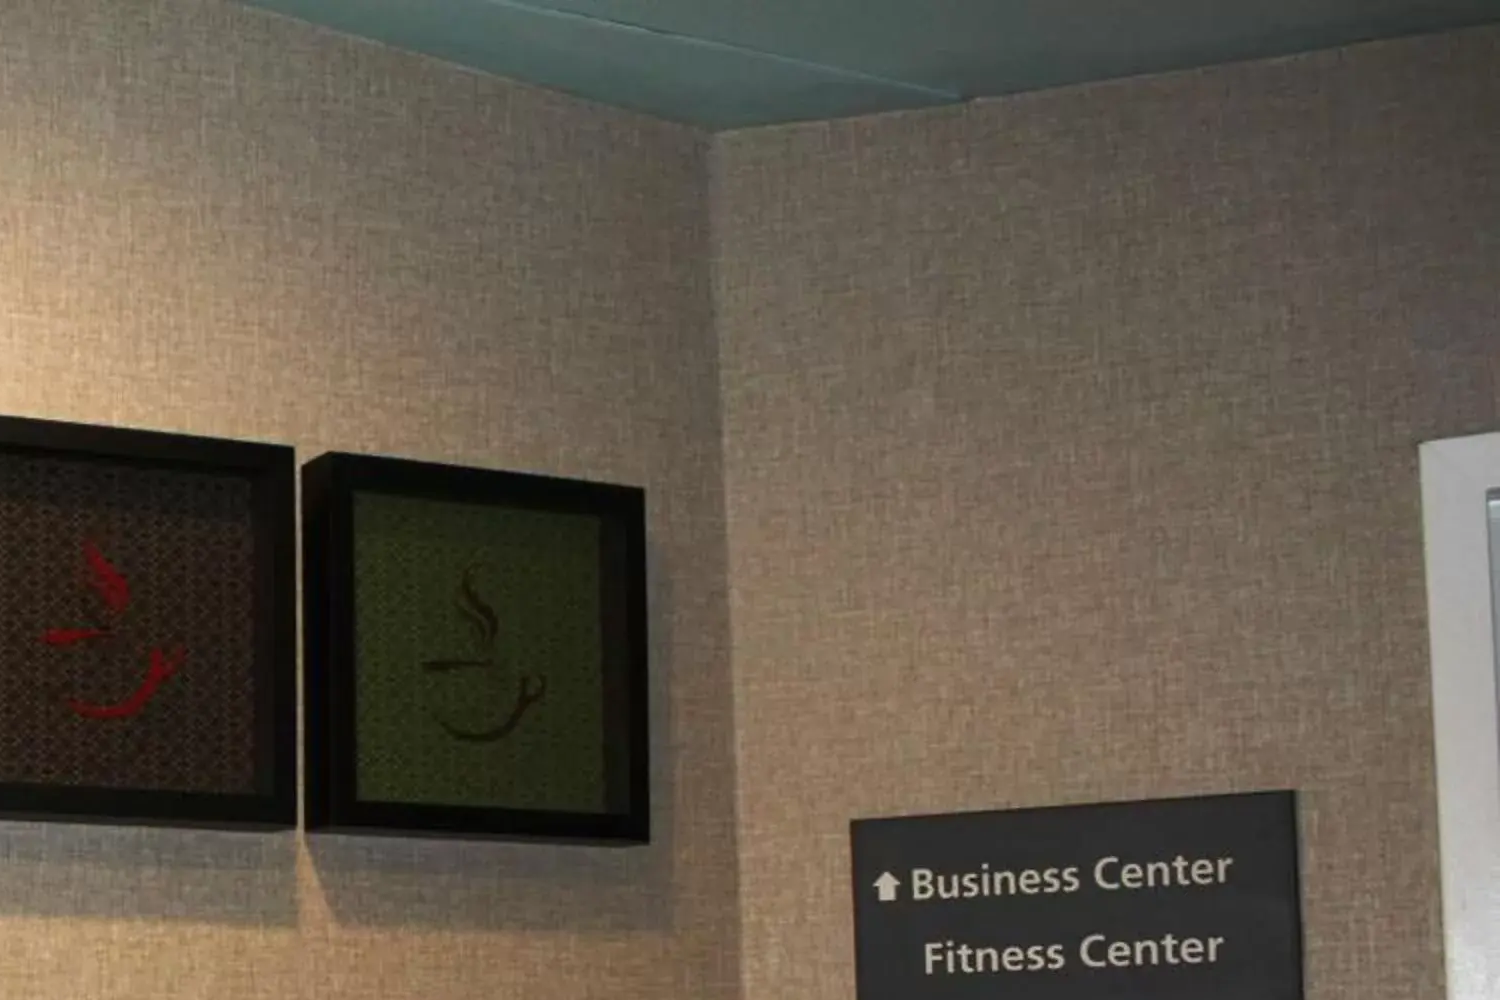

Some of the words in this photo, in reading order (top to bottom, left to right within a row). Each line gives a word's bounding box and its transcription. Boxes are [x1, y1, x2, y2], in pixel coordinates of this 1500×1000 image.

[912, 863, 1080, 900] Business
[1094, 855, 1234, 890] Center
[924, 940, 1066, 975] Fitness
[1079, 933, 1225, 968] Center
